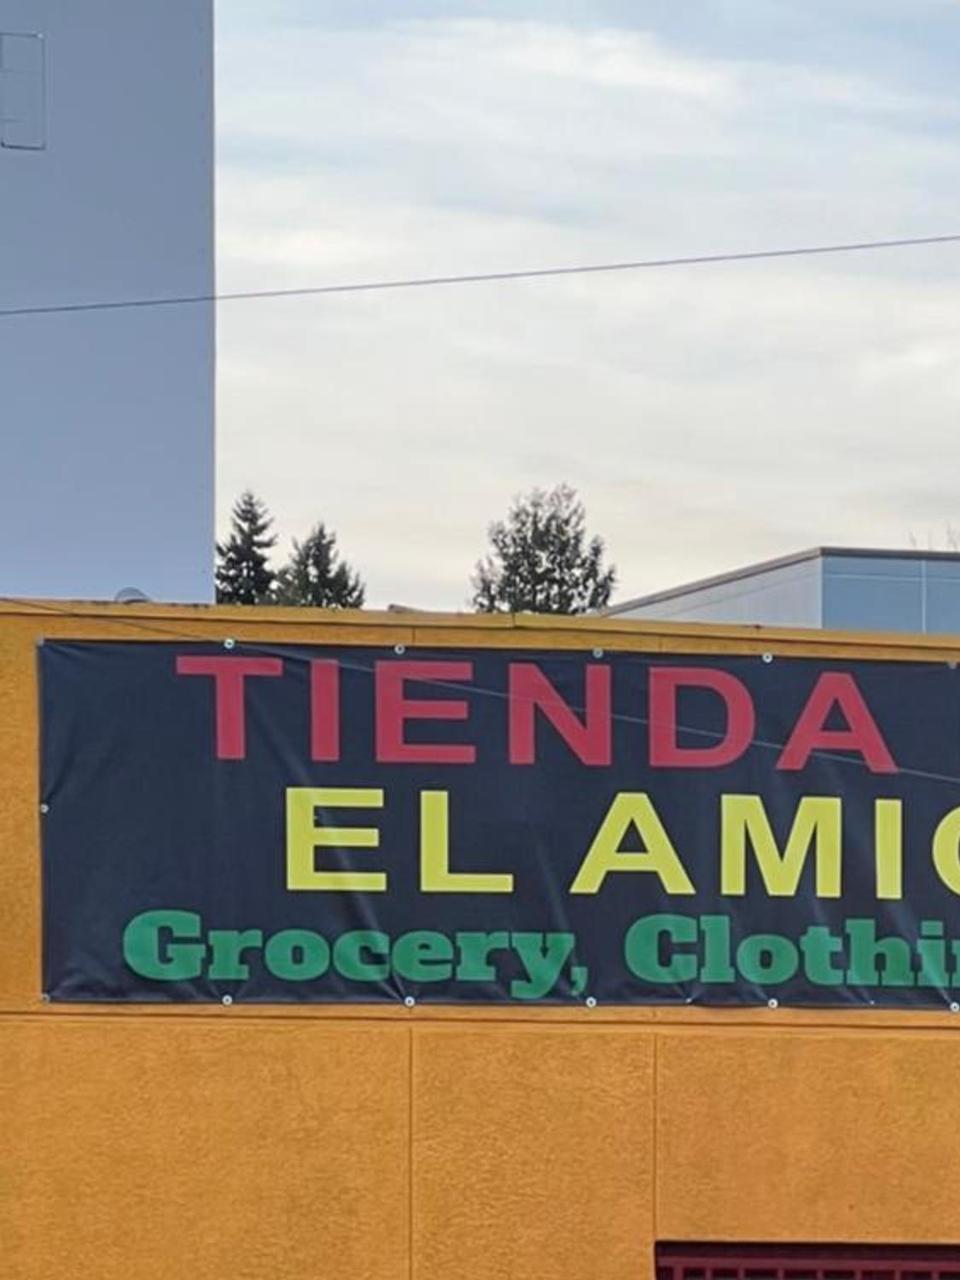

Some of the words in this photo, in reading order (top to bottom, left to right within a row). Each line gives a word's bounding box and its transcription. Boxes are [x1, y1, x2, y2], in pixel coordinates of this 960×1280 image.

[175, 654, 897, 774] TIENDA
[285, 786, 515, 894] EL
[122, 909, 589, 999] Grocery,
